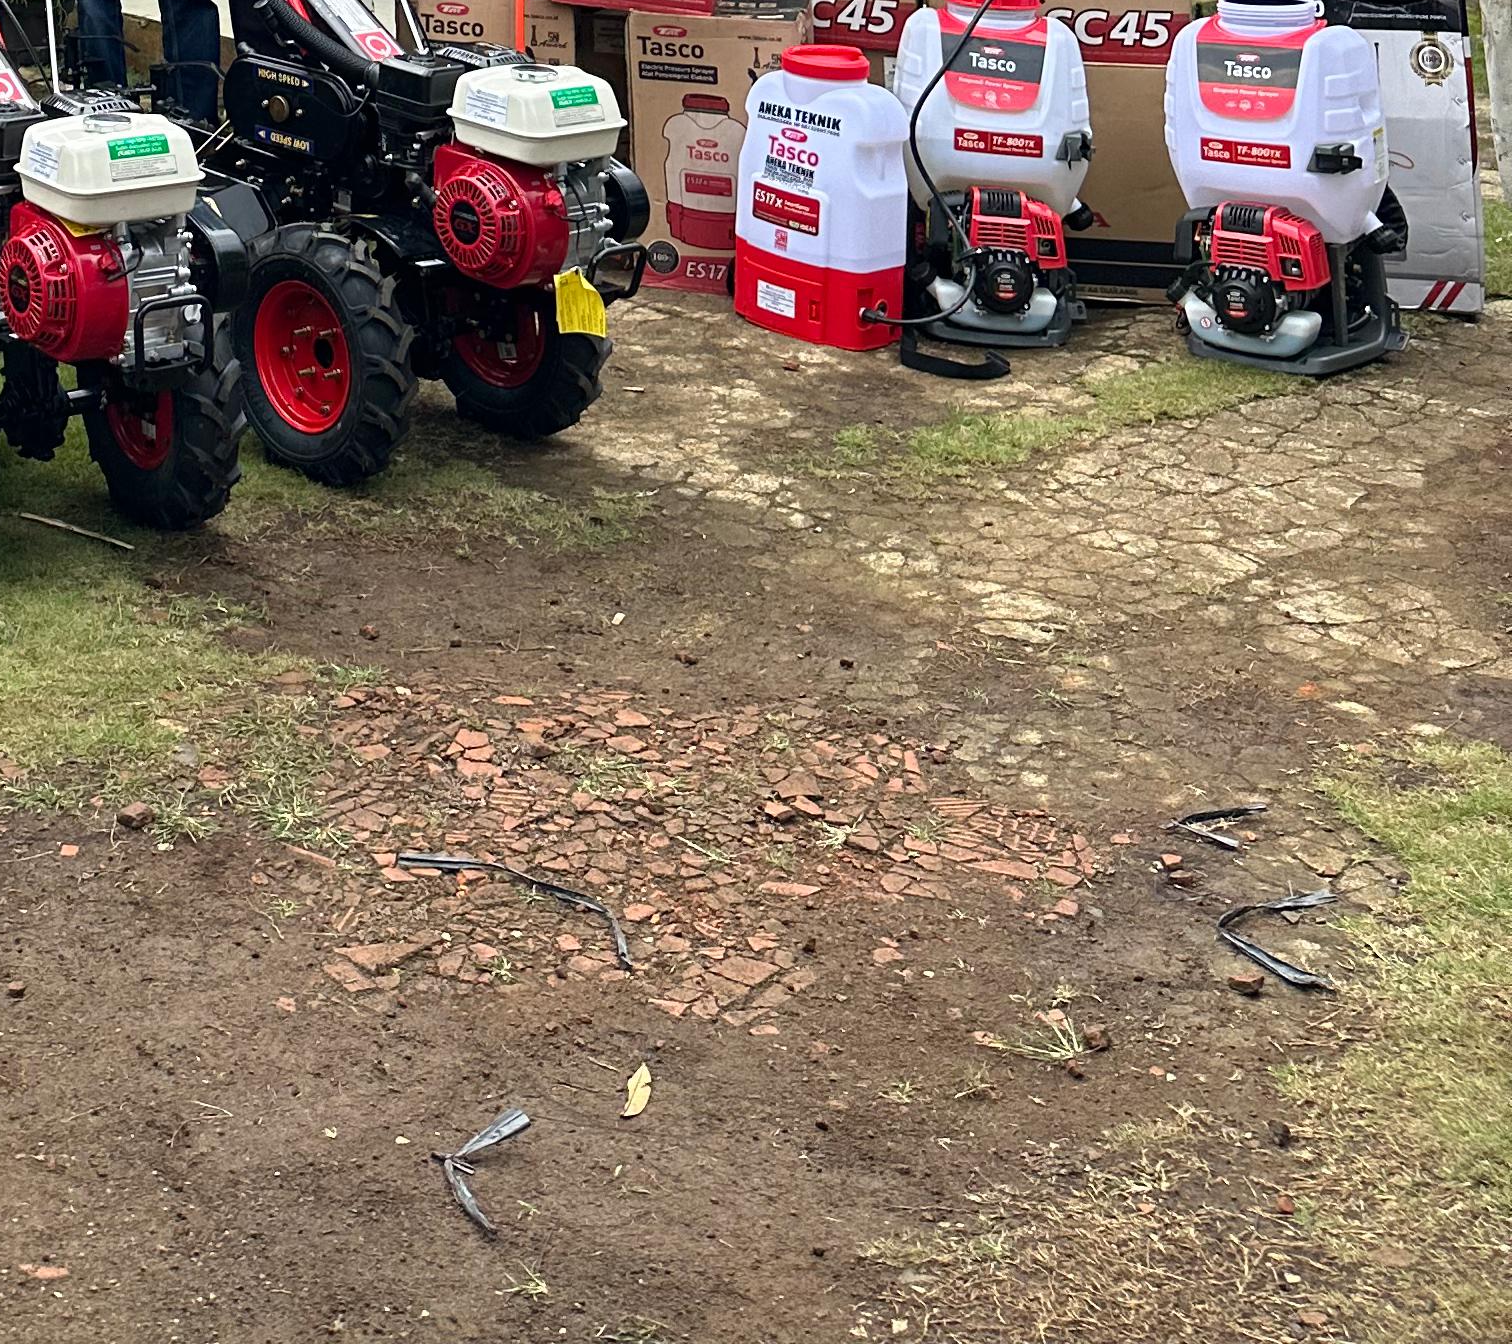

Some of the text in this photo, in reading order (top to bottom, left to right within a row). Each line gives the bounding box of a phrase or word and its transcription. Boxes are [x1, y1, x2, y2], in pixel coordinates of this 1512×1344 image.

[420, 13, 485, 38] Tasco
[637, 35, 705, 60] Tasco
[969, 51, 1017, 73] Tasco
[1223, 60, 1273, 80] Tasco
[257, 67, 301, 87] HIGH SPEED
[758, 100, 792, 120] ANEKA
[794, 108, 842, 132] TEKNIK
[269, 131, 311, 153] LOW SPEED
[768, 134, 820, 168] Tasco
[956, 136, 986, 150] Tasco
[1202, 145, 1231, 160] Tasco
[685, 145, 730, 163] Tasco
